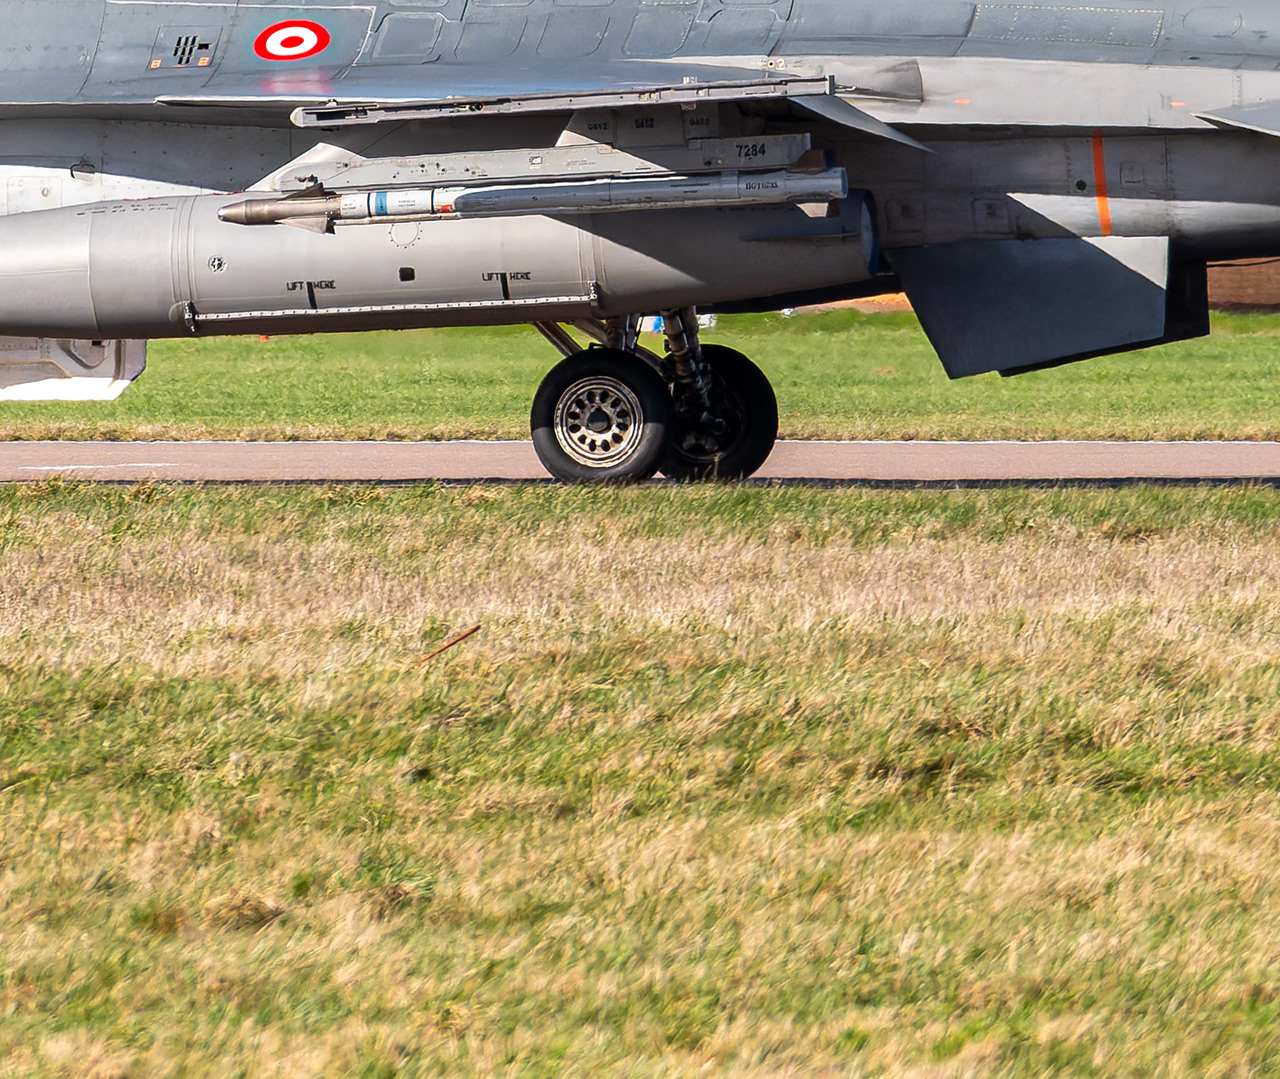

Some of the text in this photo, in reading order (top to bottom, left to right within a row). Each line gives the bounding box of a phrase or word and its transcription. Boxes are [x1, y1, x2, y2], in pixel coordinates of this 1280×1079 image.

[736, 143, 766, 157] 7284
[482, 272, 531, 282] LIFT HERE
[286, 280, 337, 291] LIFT HERE
